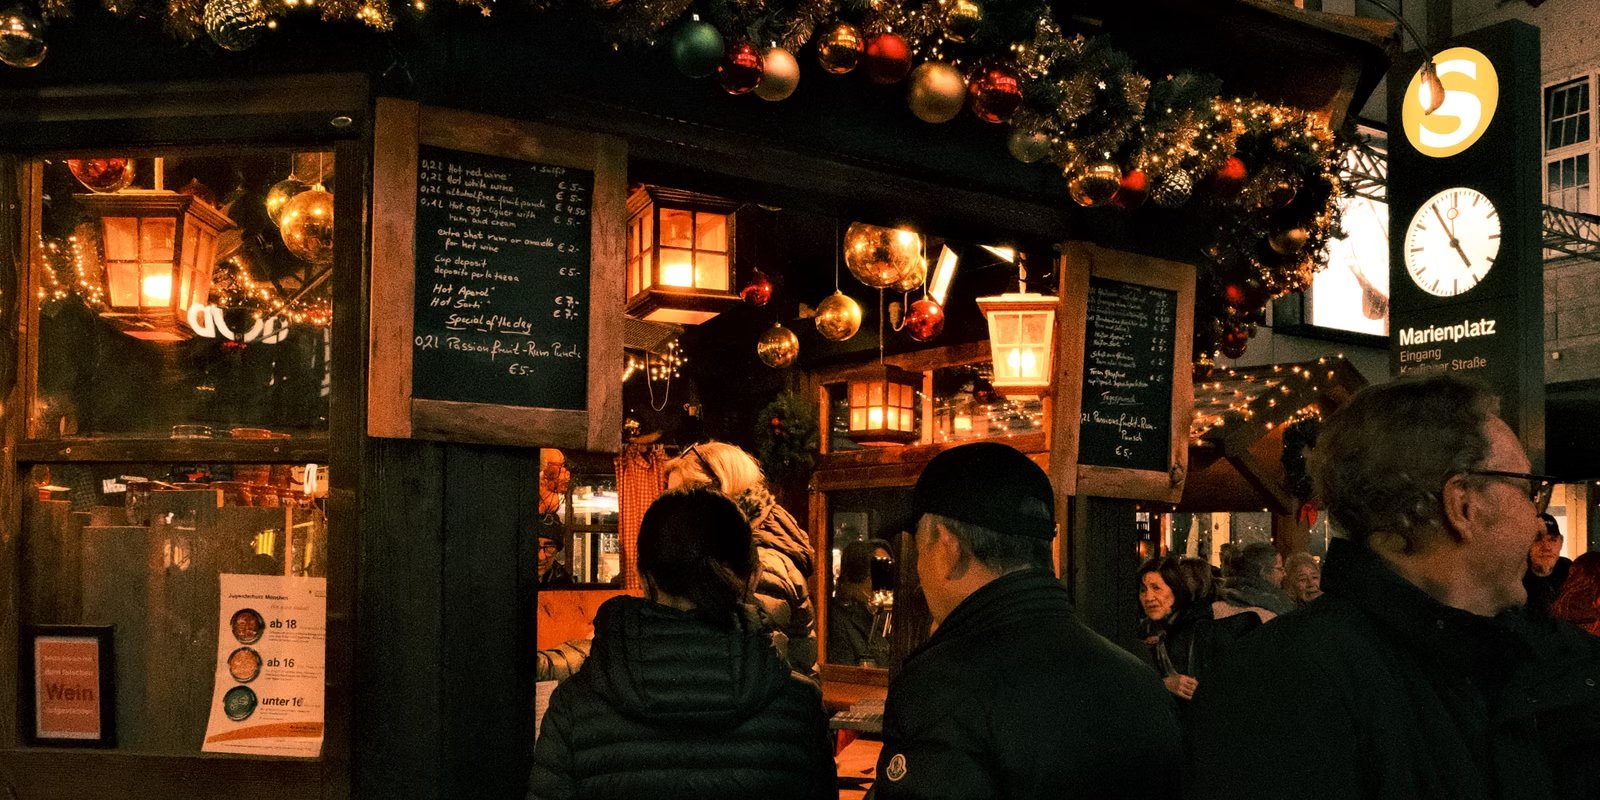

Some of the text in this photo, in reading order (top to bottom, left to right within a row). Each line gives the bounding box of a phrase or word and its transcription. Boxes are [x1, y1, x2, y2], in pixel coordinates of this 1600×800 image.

[1419, 59, 1482, 148] S
[448, 164, 462, 175] Hot
[466, 167, 482, 177] red
[447, 175, 462, 184] Hot
[465, 179, 487, 189] white
[449, 201, 464, 209] Hot
[516, 210, 536, 219] with
[449, 213, 516, 228] rum and cream
[437, 227, 460, 238] extra
[463, 229, 484, 240] shot
[487, 234, 507, 242] rum
[445, 238, 500, 253] for hot wine
[434, 254, 487, 269] Cup deposit
[434, 265, 468, 278] deposito
[432, 283, 453, 294] Hot
[430, 296, 452, 308] Hot
[445, 313, 533, 335] Special of the day
[1399, 318, 1496, 346] Marienplatz
[1400, 348, 1442, 363] Eingang
[1451, 356, 1487, 371] Straße
[1115, 445, 1123, 456] €
[269, 619, 282, 629] ab
[286, 619, 297, 629] 18
[267, 658, 280, 668] ab
[283, 658, 295, 668] 16
[45, 682, 94, 701] Wein
[262, 697, 290, 707] unter
[292, 697, 304, 707] 16
